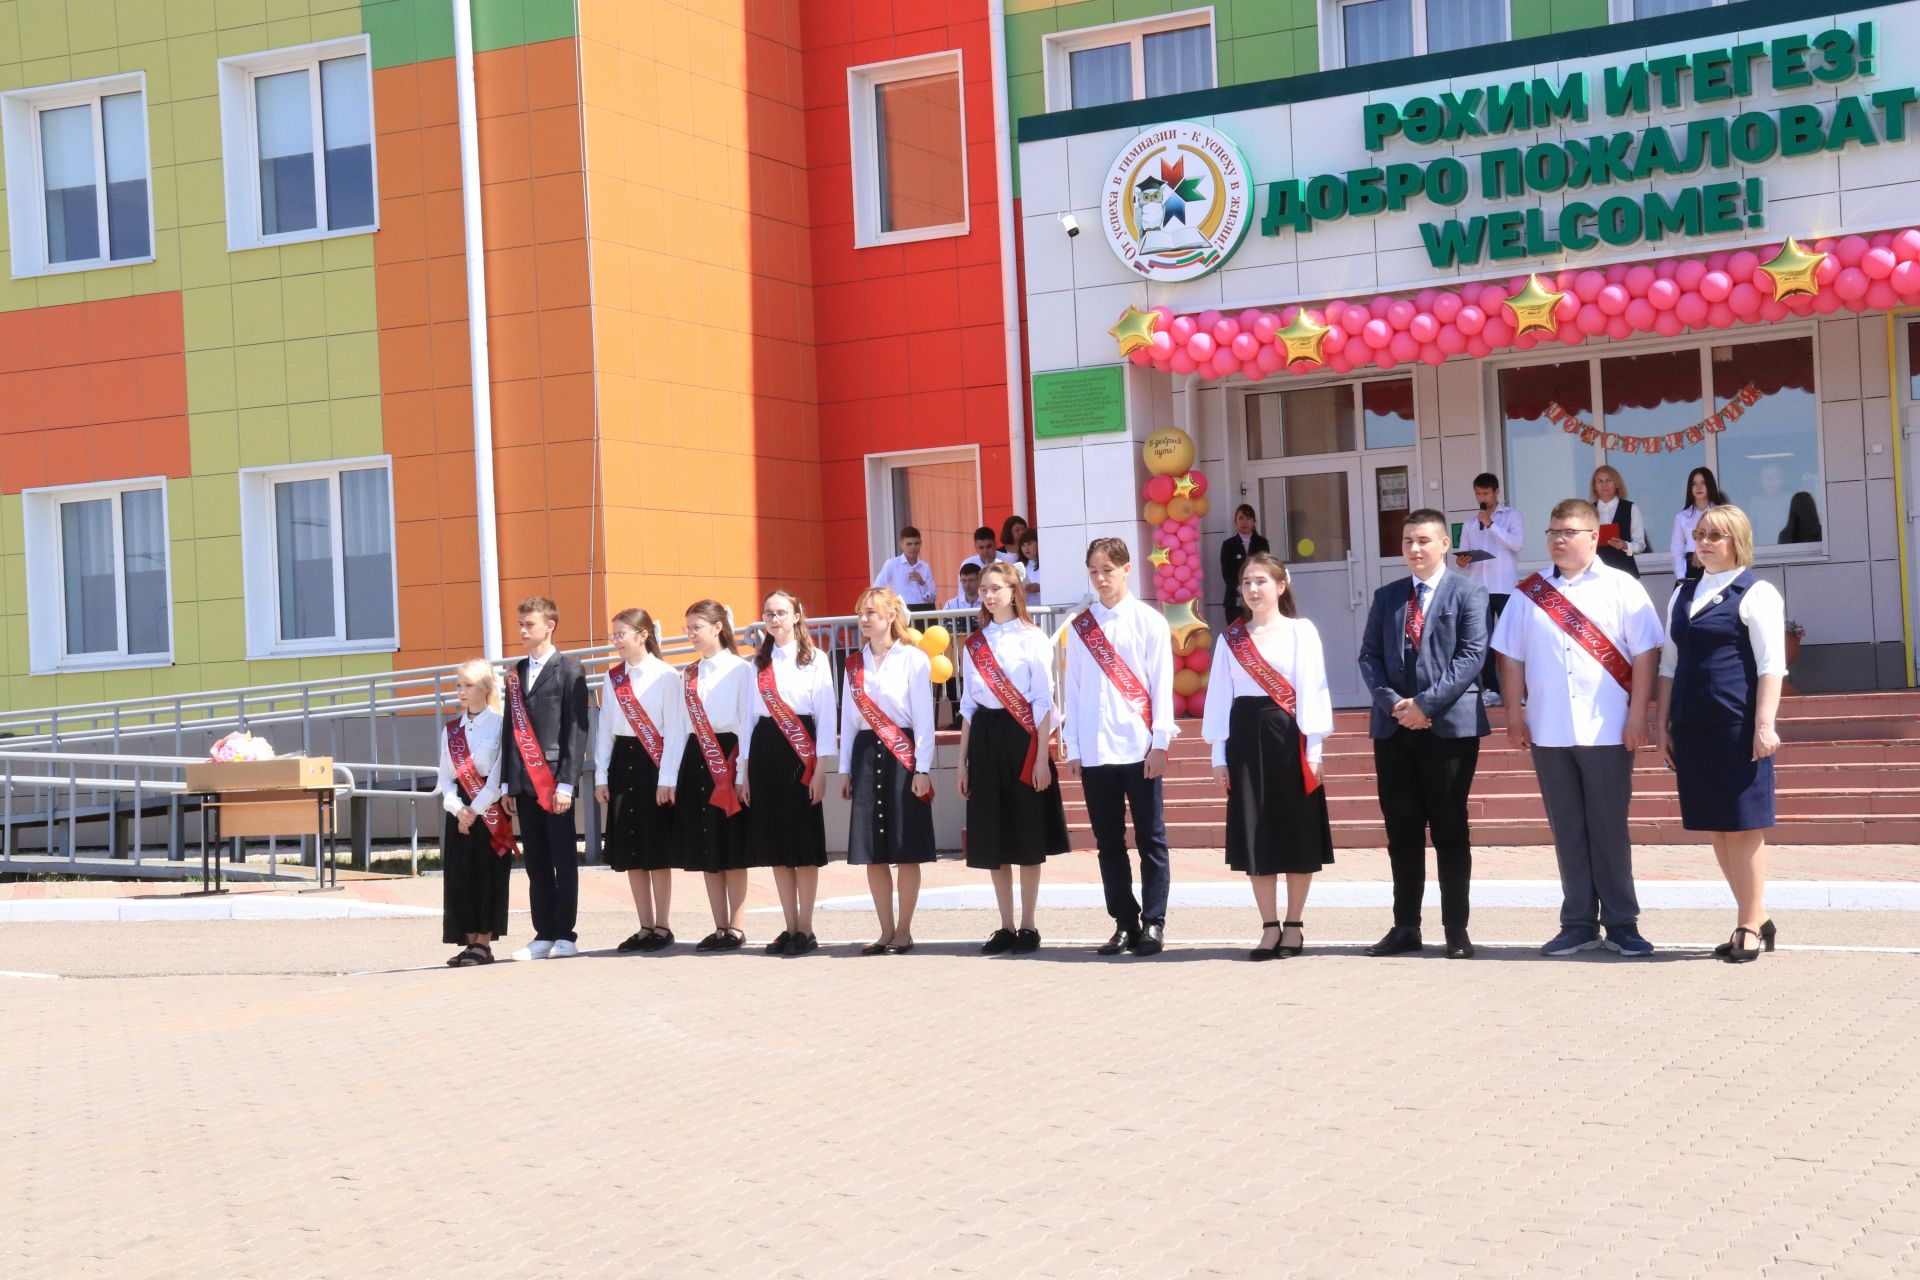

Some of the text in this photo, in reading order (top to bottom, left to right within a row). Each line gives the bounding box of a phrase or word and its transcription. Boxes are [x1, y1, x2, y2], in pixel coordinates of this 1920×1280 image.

[1363, 21, 1876, 152] РӘХИМ ИТЕГЕЗ!
[1118, 129, 1177, 174] гимназии
[1201, 136, 1238, 176] успеху
[1108, 191, 1128, 240] успеха
[1214, 195, 1241, 251] жизни!
[1261, 157, 1468, 237] ДОБРО
[1418, 177, 1764, 269] WELCOME!
[1121, 241, 1137, 260] От
[1538, 591, 1601, 648] Выпускник
[1085, 629, 1135, 690] Выпускник
[1231, 636, 1285, 694] Выпускница
[519, 735, 543, 768] 2023
[702, 742, 728, 774] 2023
[783, 726, 815, 757] 2023
